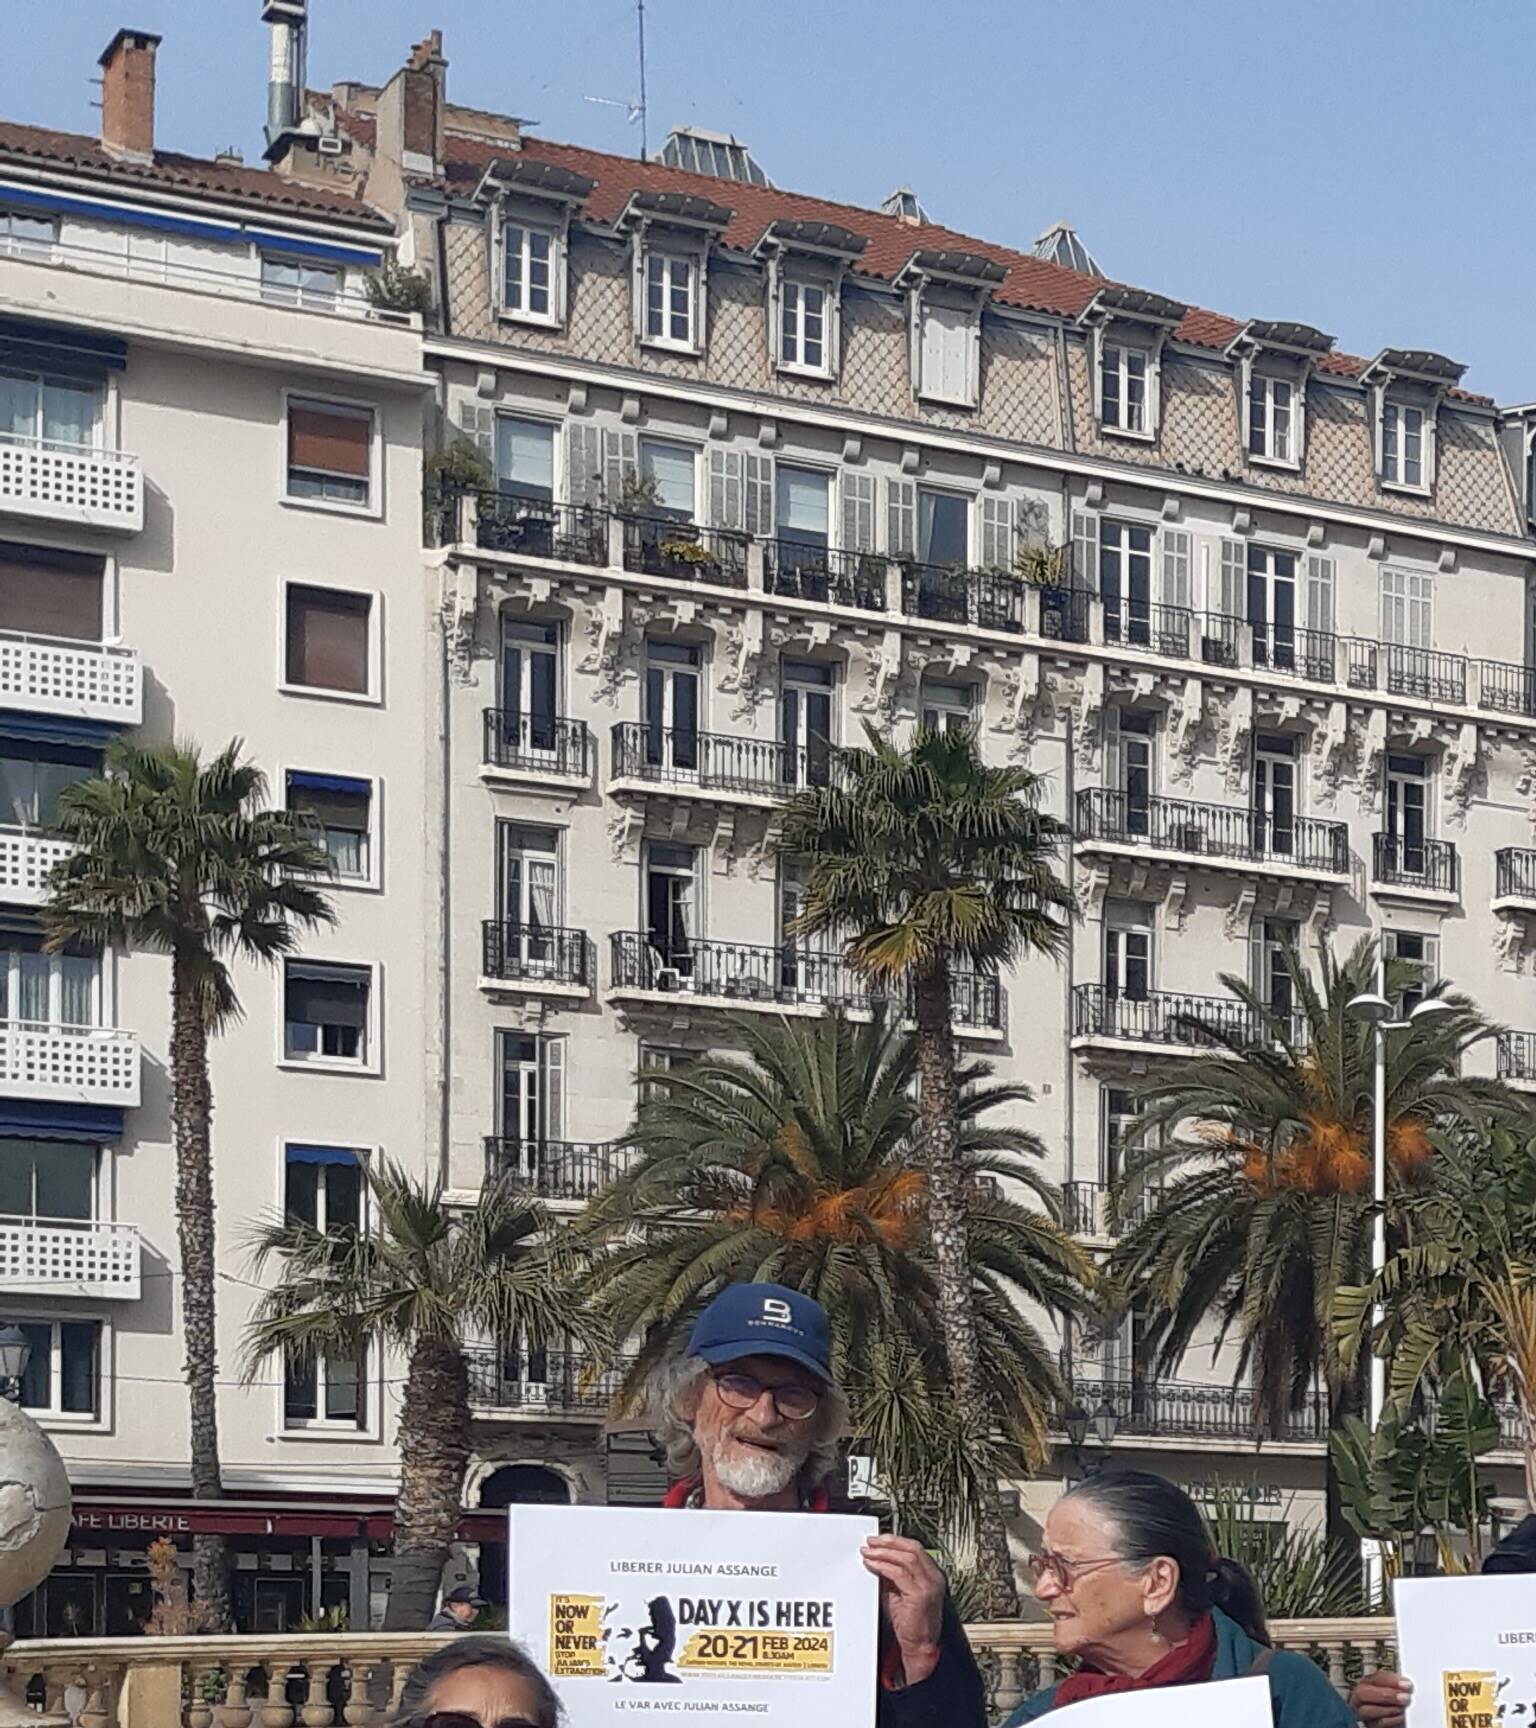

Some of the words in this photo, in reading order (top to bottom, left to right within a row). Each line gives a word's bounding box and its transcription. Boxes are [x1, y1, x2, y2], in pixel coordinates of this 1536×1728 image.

[678, 1598, 723, 1626] DAY
[726, 1600, 742, 1627] X
[748, 1601, 770, 1627] IS
[776, 1601, 833, 1628] HERE
[697, 1635, 758, 1659] 20-21
[762, 1636, 789, 1650] FEB
[793, 1637, 829, 1651] 2024
